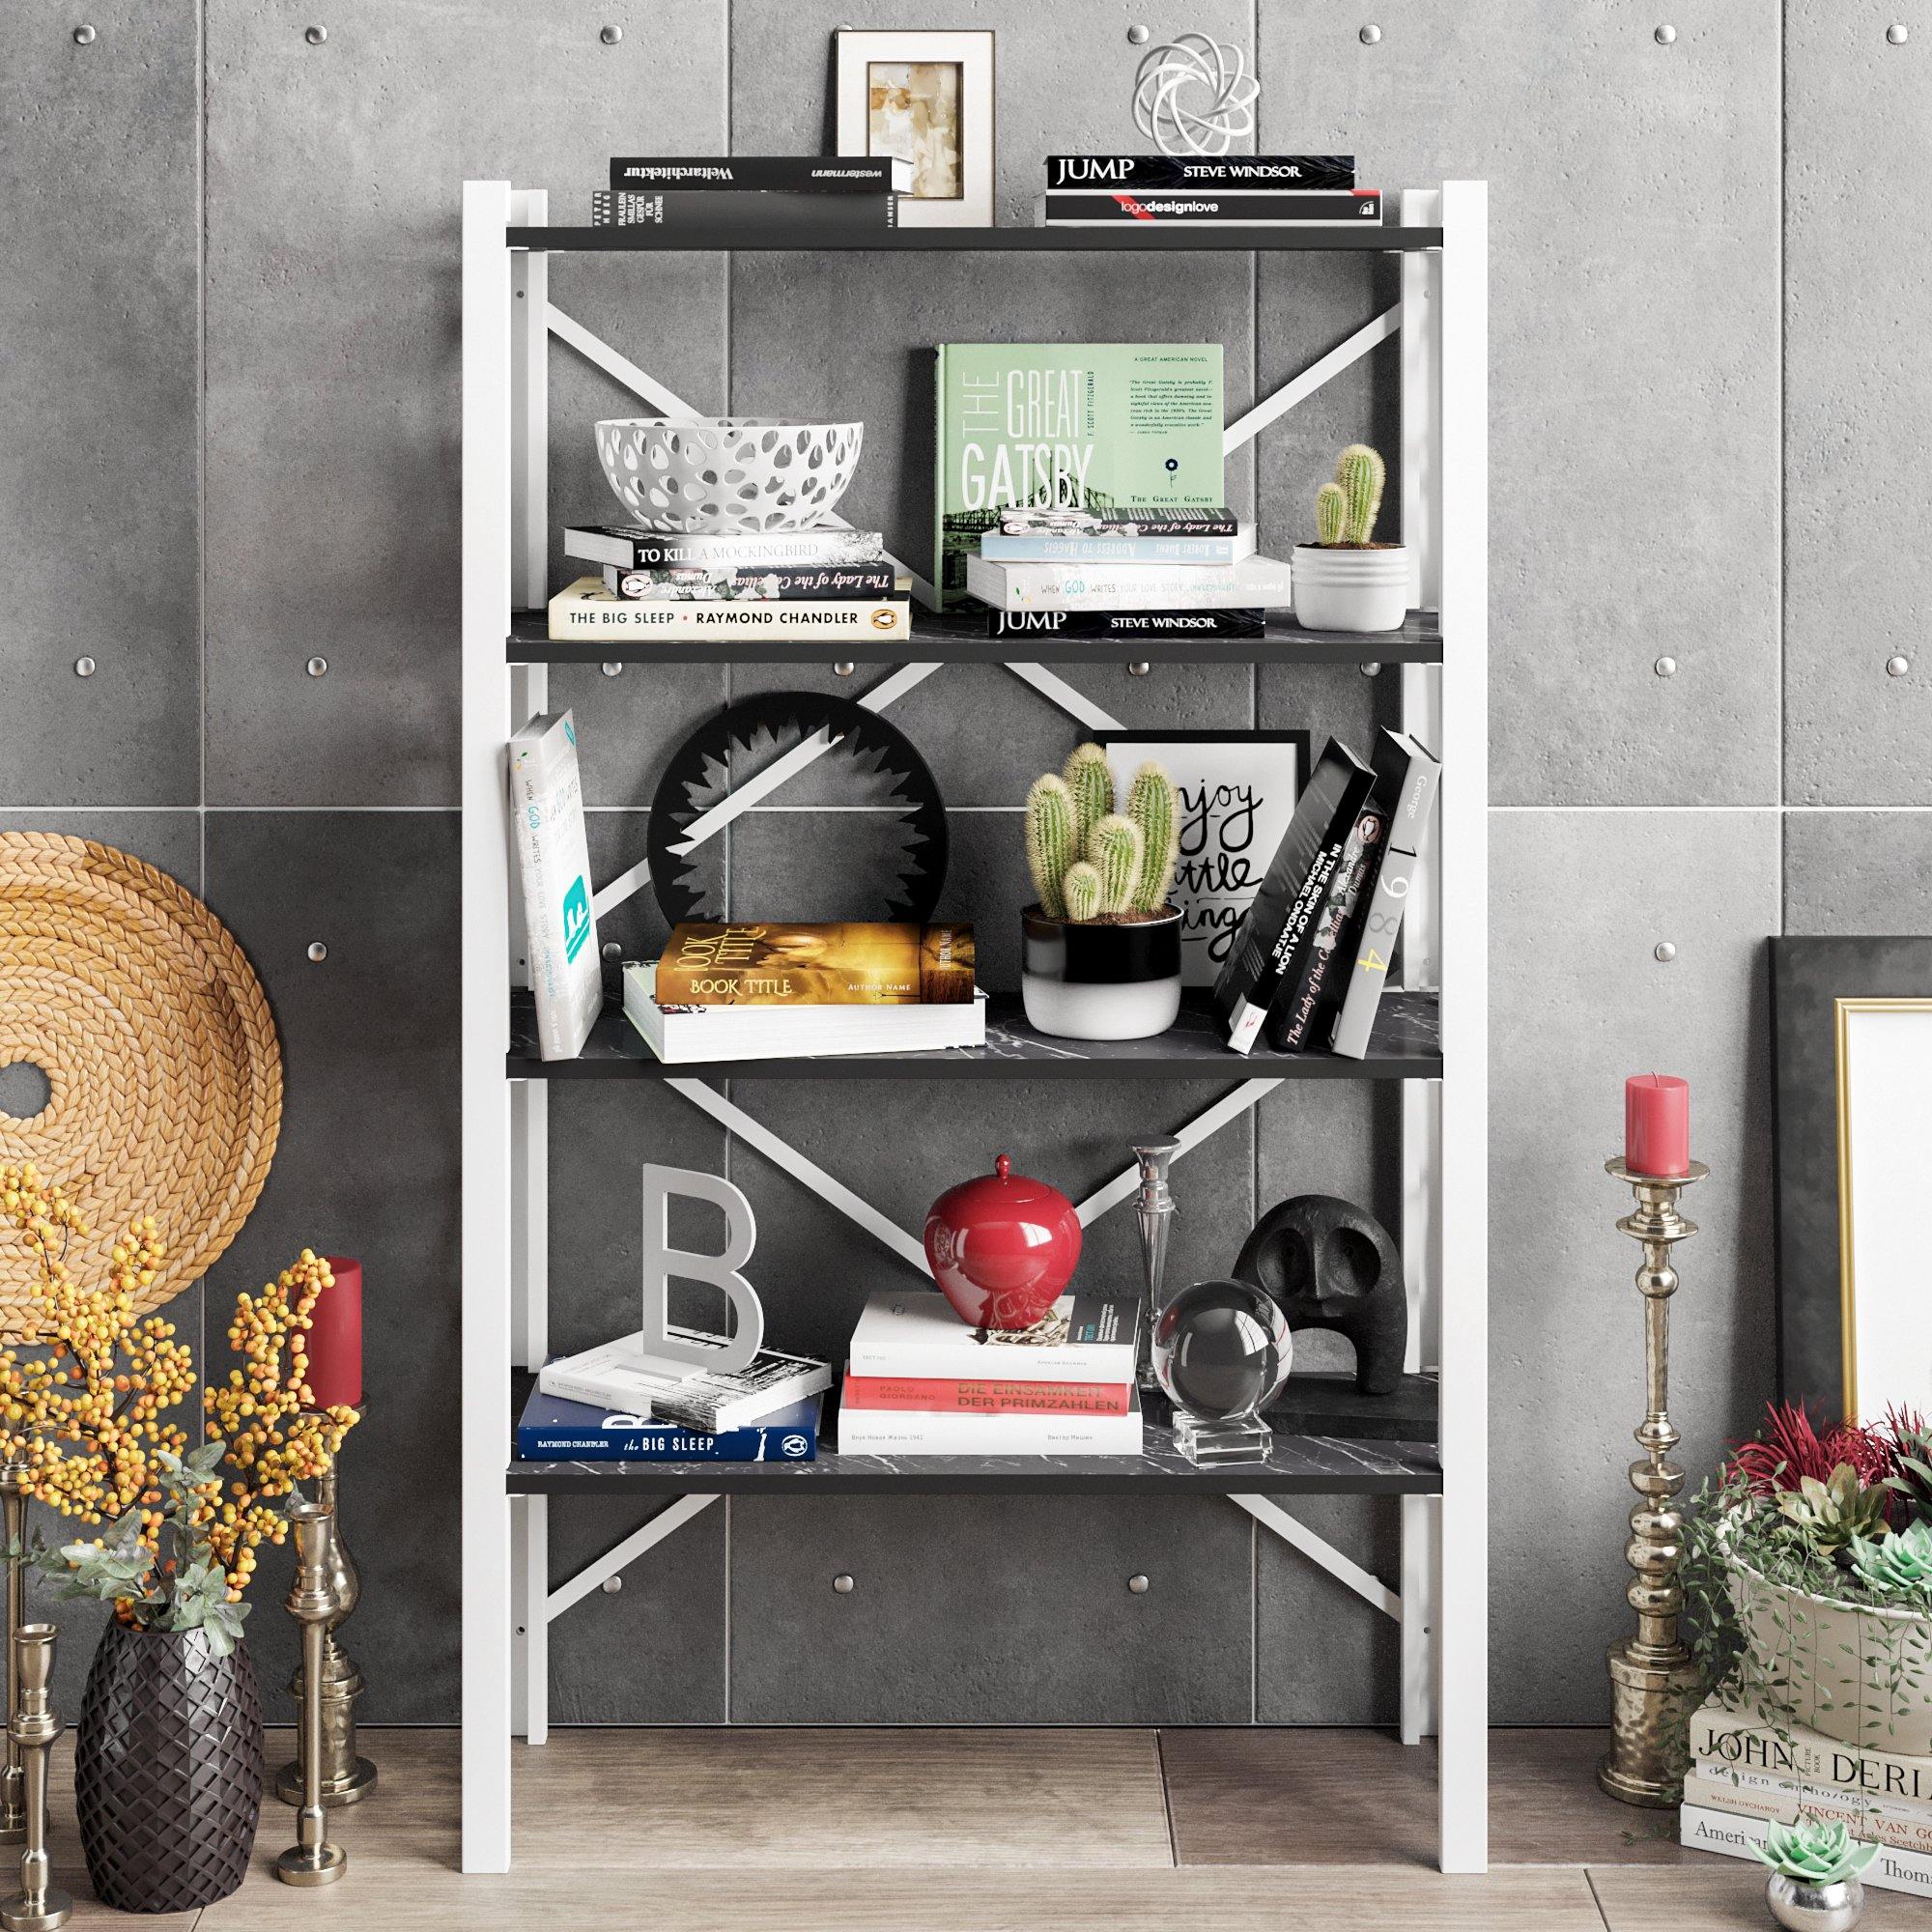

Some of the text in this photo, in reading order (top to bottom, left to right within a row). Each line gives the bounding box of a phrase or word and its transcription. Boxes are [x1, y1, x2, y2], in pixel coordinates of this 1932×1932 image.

[623, 167, 733, 181] Weltarchitektur
[811, 169, 883, 179] westermann
[1057, 158, 1303, 185] JUMP STEVE WINDSOR
[1121, 201, 1219, 214] logodesignlove
[962, 370, 1000, 440] THE
[1007, 369, 1083, 439] GREAT
[961, 443, 1094, 509] GATSBY
[1151, 523, 1234, 533] The Lady of the
[638, 543, 818, 562] TO KILL A MOCKINGBIRD
[794, 572, 890, 589] The Lady of the
[1040, 584, 1060, 594] WHEN
[1065, 581, 1085, 593] GOD
[1091, 583, 1117, 594] WRITES
[570, 612, 858, 624] THE BIG SLEEP RAYMOND CHANDLER
[997, 611, 1218, 635] JUMP STEVE WINDSOR
[525, 779, 534, 801] WHEN
[1406, 775, 1428, 819] George
[527, 806, 541, 829] GOD
[531, 834, 542, 864] WRITES
[1271, 850, 1327, 958] MICHAEL ONDAATJE
[1275, 842, 1343, 976] IN THE SKIN OF A LION
[690, 979, 793, 997] BOOK TITLE
[1287, 962, 1325, 1045] The Lady of the
[642, 1162, 765, 1375] B
[957, 1382, 1103, 1398] DIE EINSAMKEIT
[957, 1397, 1120, 1410] DER PRIMZAHLEN
[623, 1437, 714, 1451] the BIG SLEEP
[1698, 1728, 1793, 1773] JOHN
[1832, 1752, 1932, 1801] DERI
[1797, 1804, 1868, 1828] VINCENT
[1875, 1819, 1908, 1835] VAN
[1880, 1858, 1932, 1885] Thom
